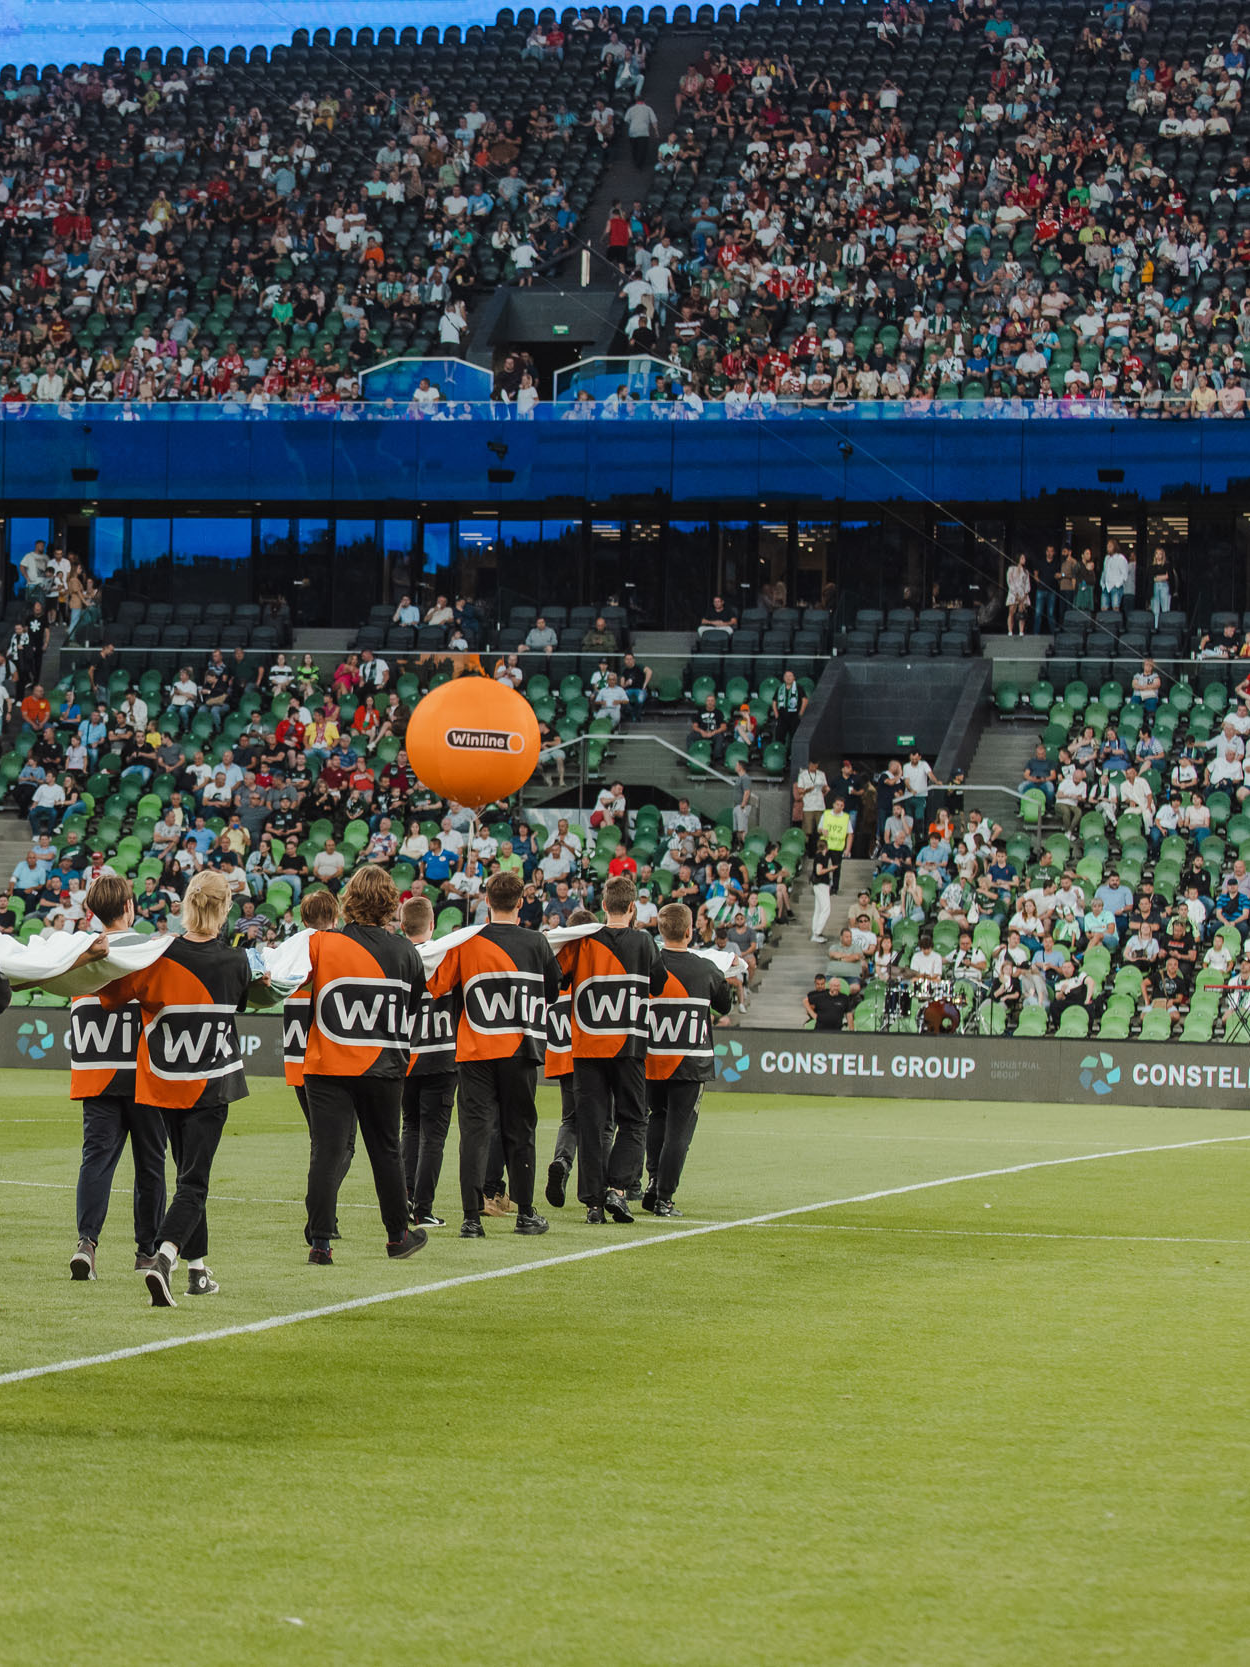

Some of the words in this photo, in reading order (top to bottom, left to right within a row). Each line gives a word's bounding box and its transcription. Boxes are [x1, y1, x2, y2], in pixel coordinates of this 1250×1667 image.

[451, 731, 505, 748] Winline
[408, 1004, 453, 1039] in
[474, 986, 547, 1025] Win
[587, 987, 649, 1025] Win
[72, 1012, 141, 1054] Wi
[760, 1051, 885, 1077] CONSTELL
[890, 1055, 976, 1079] GROUP
[1132, 1063, 1250, 1089] CONSTEL
